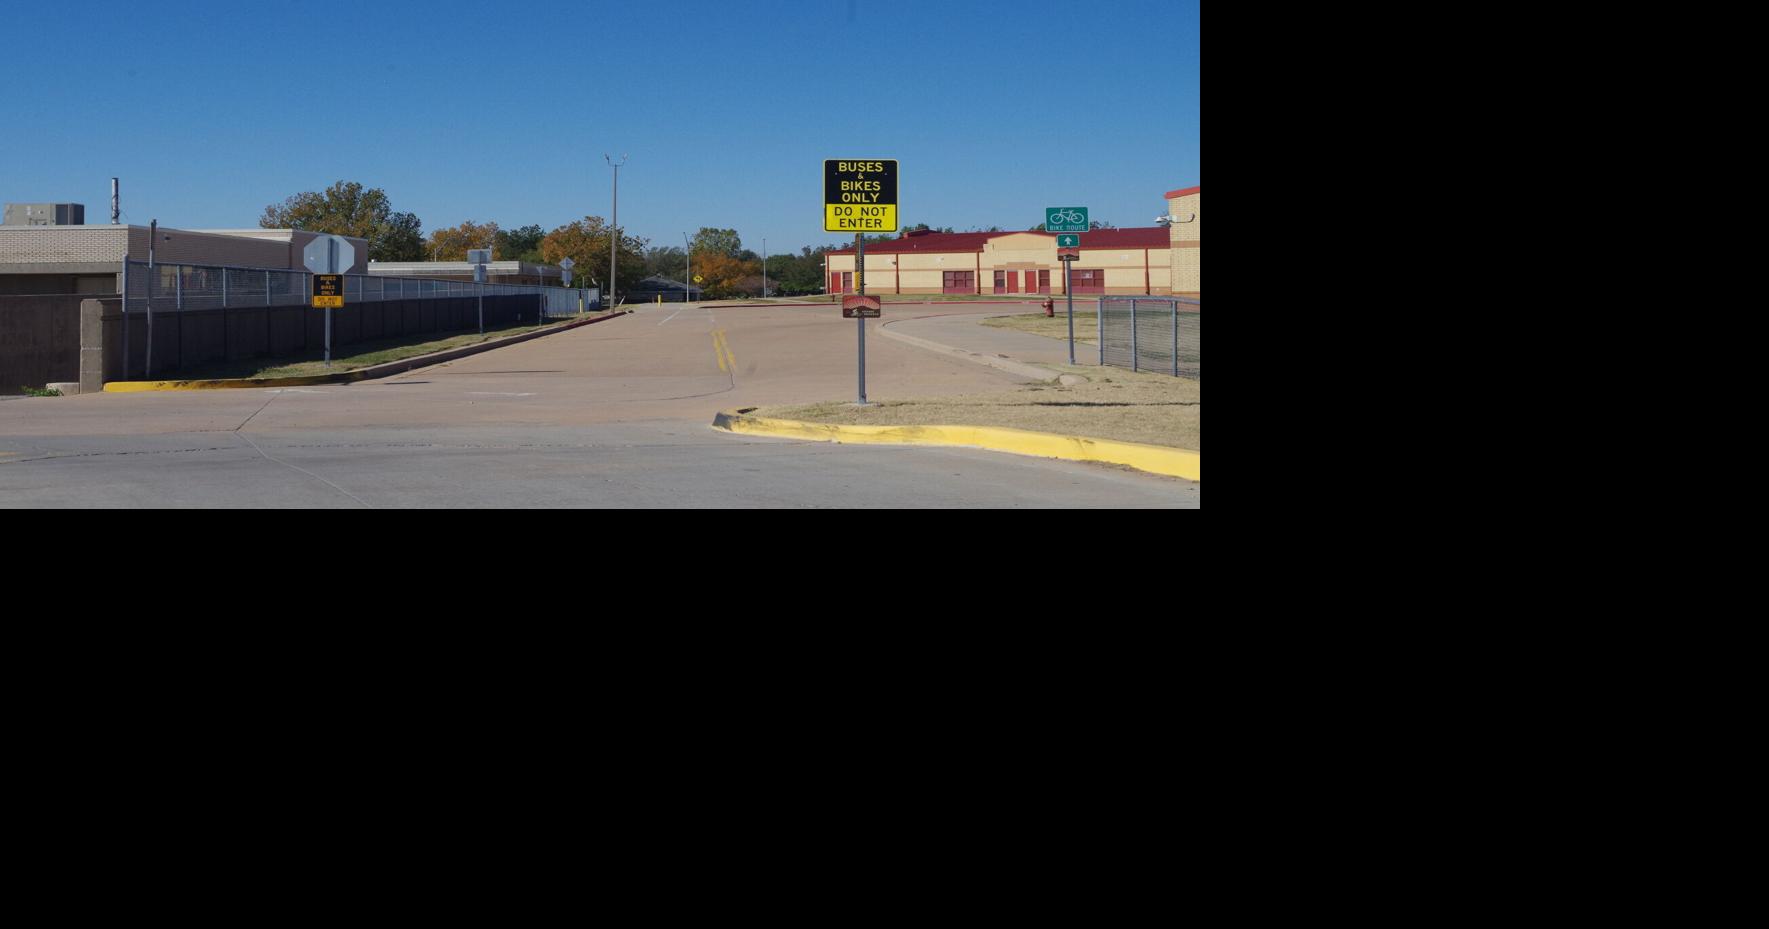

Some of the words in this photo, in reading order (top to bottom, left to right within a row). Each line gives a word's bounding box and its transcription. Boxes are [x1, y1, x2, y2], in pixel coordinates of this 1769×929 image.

[838, 162, 884, 172] BUSES
[841, 181, 881, 191] BIKES
[841, 193, 880, 203] ONLY
[834, 207, 853, 216] DO
[861, 207, 888, 216] NOT
[839, 218, 882, 228] ENTER
